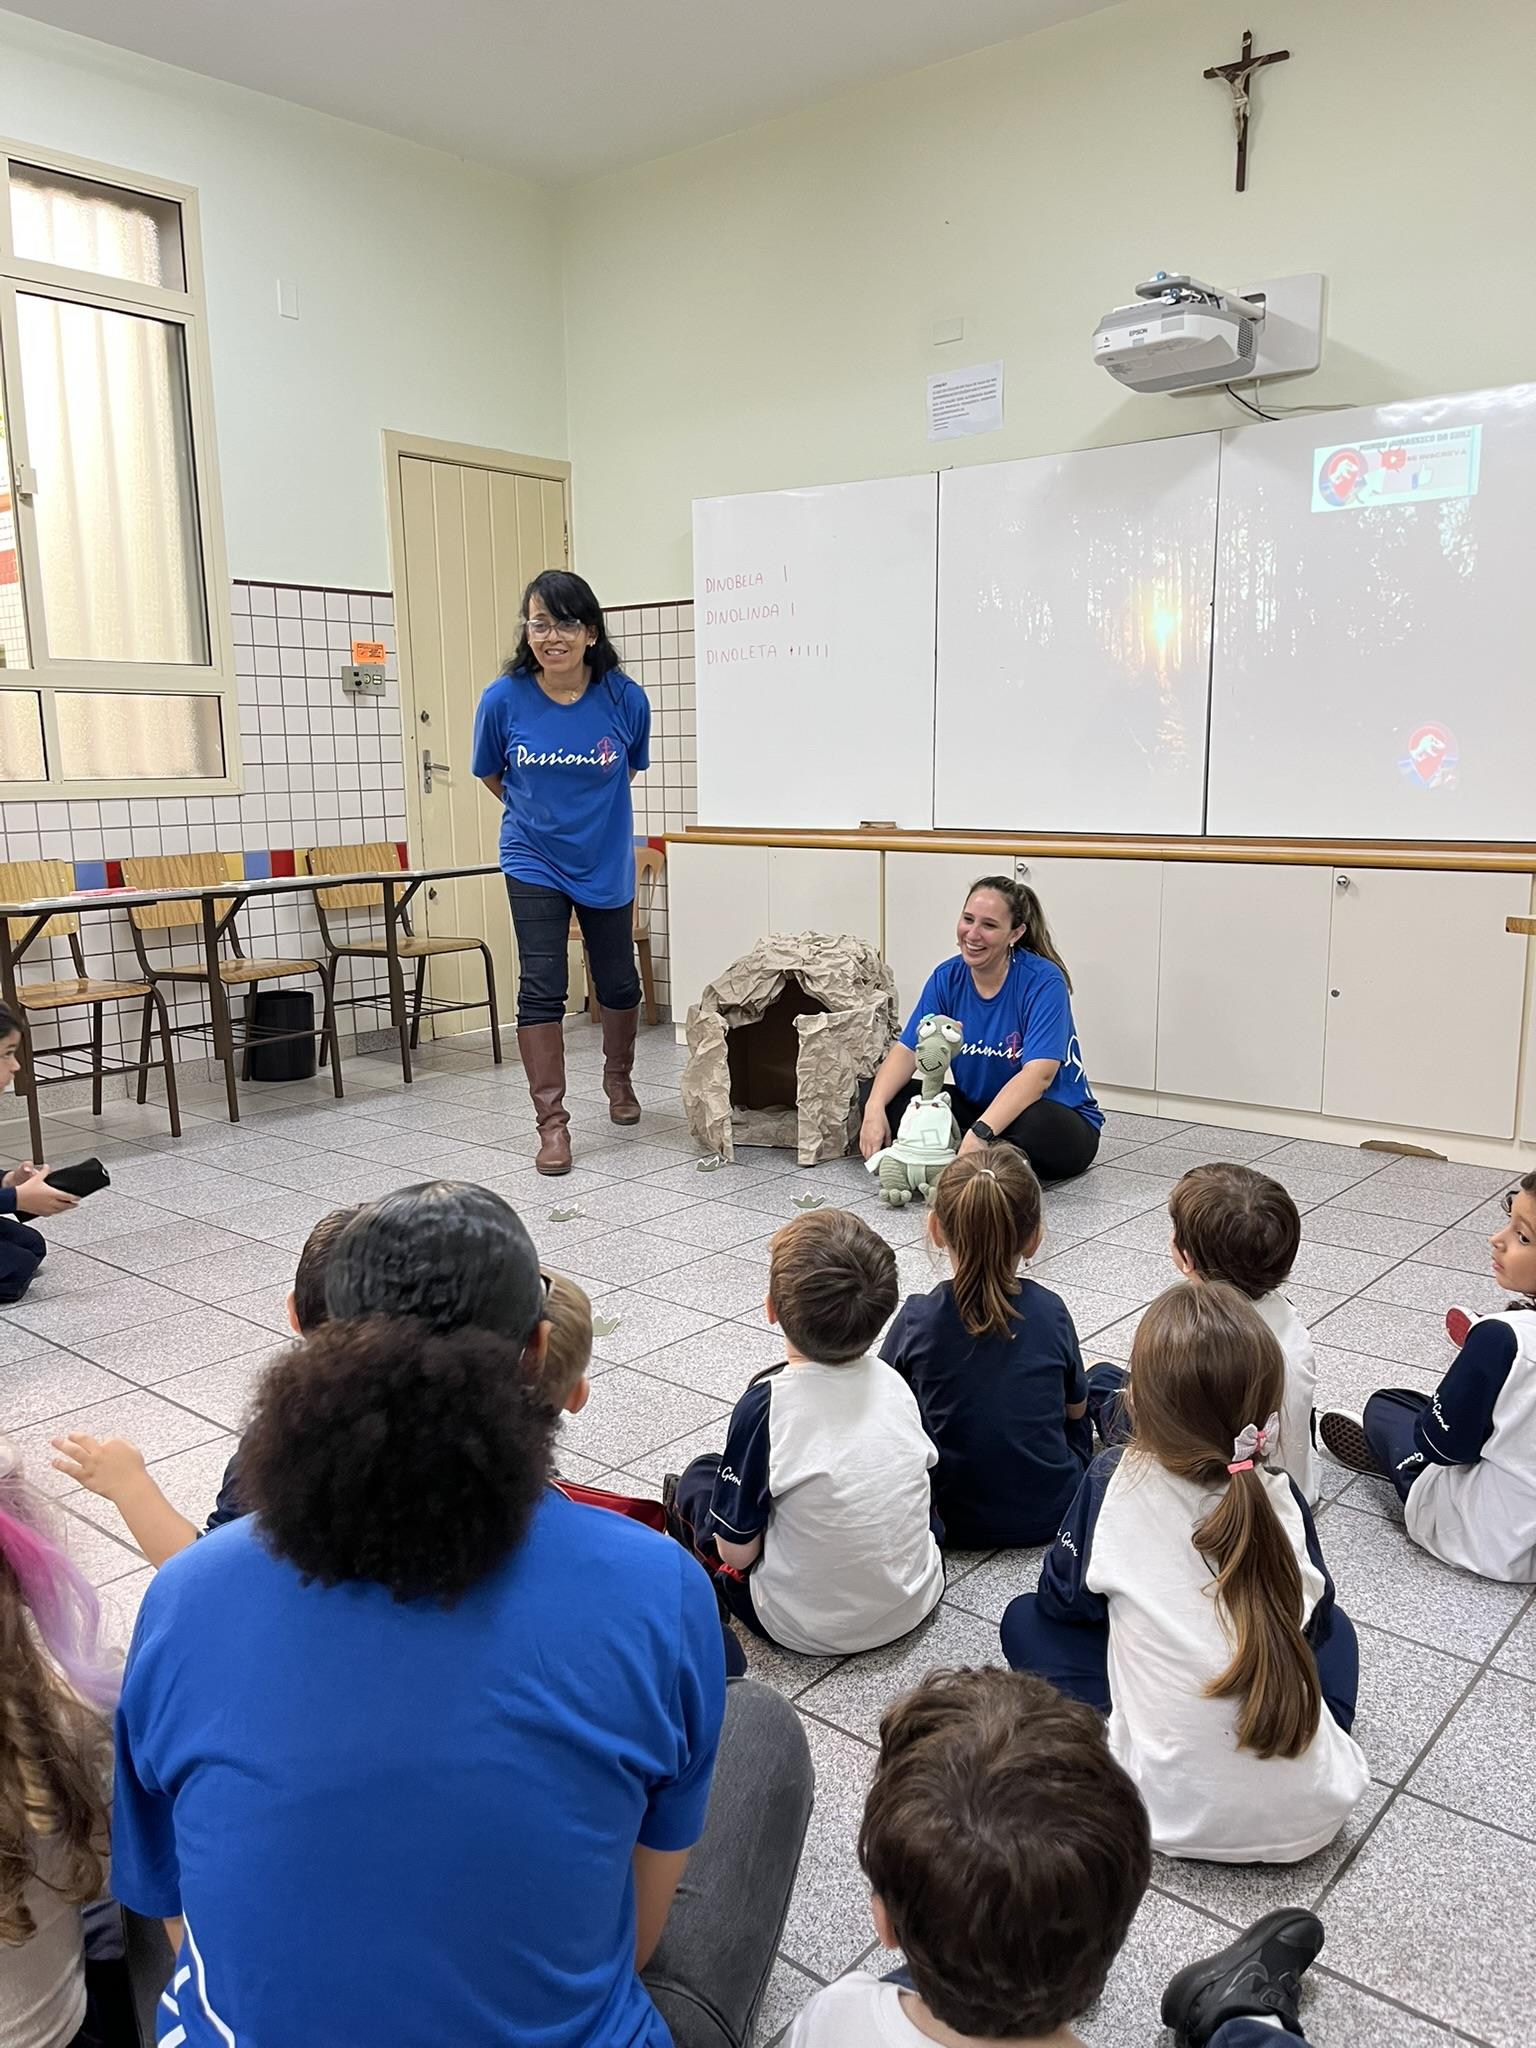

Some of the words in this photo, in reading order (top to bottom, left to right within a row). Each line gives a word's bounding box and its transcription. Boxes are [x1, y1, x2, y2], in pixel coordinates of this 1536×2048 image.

[1129, 328, 1148, 336] EPSON
[705, 572, 763, 594] DINOBELA
[706, 603, 779, 625] DINOLINDA
[706, 644, 777, 665] DINOLETA
